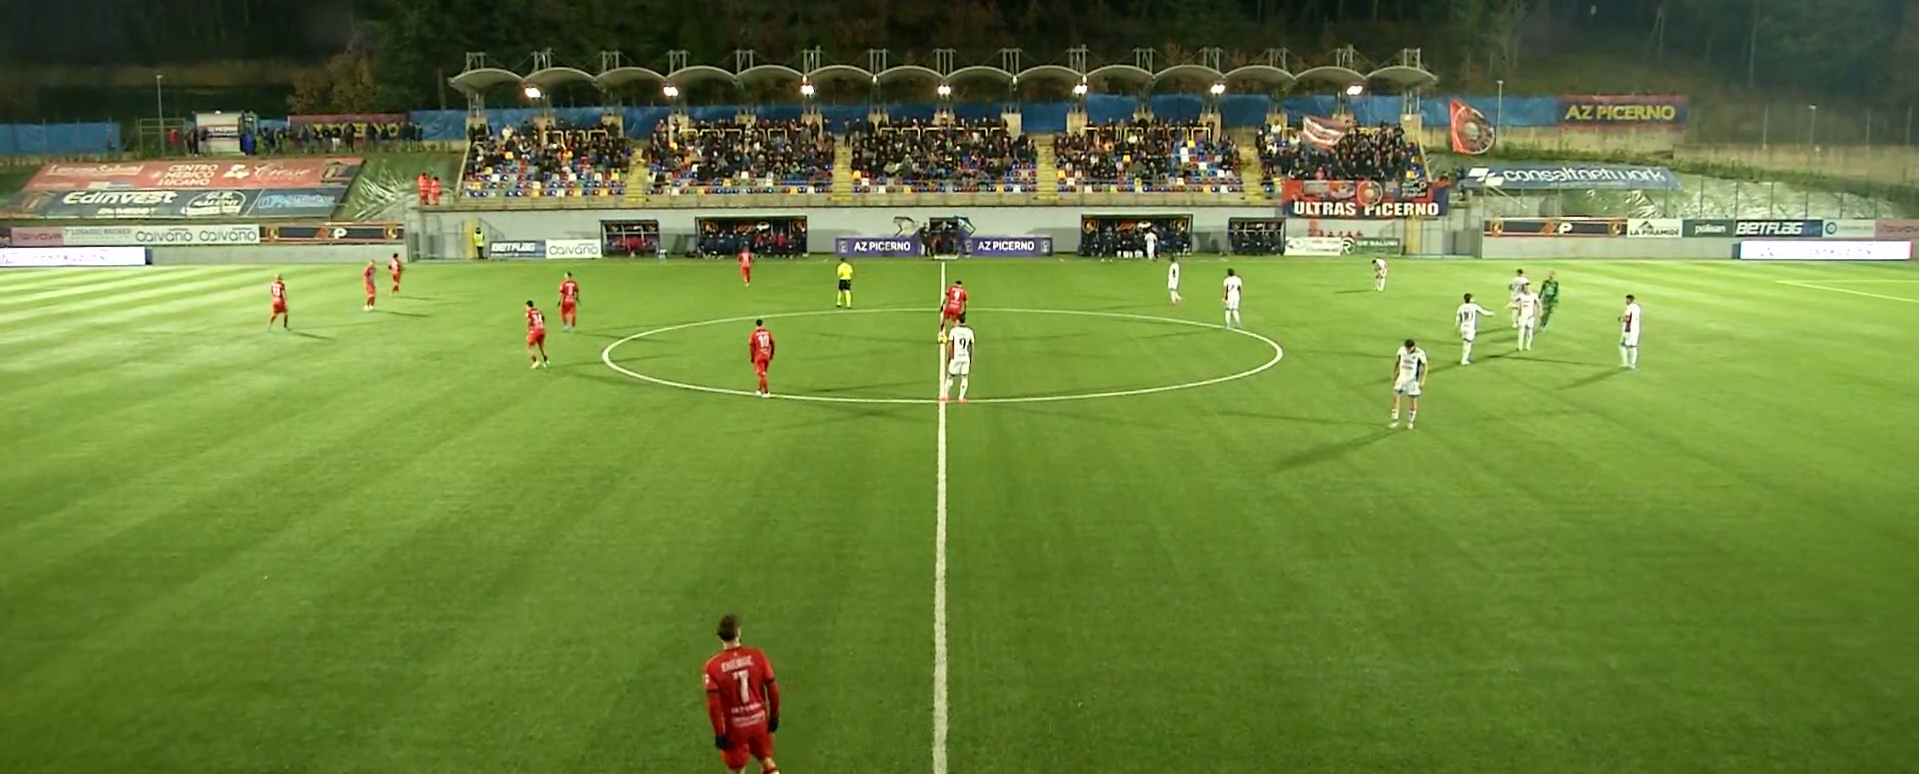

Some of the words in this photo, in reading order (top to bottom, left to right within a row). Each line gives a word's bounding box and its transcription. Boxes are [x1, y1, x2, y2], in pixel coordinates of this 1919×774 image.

[1564, 105, 1593, 121] AZ
[1597, 105, 1675, 121] PICERNO
[168, 164, 219, 172] CENTRO
[163, 171, 215, 179] MEDICO
[157, 178, 211, 186] LUCANO
[1294, 201, 1356, 216] ULTRAS
[1736, 222, 1804, 235] BETFLAG
[853, 241, 868, 251] AZ
[869, 241, 911, 251] PICERNO
[977, 241, 991, 250] AZ
[993, 240, 1035, 250] PICERNO
[758, 334, 770, 348] 10
[959, 337, 967, 350] 9
